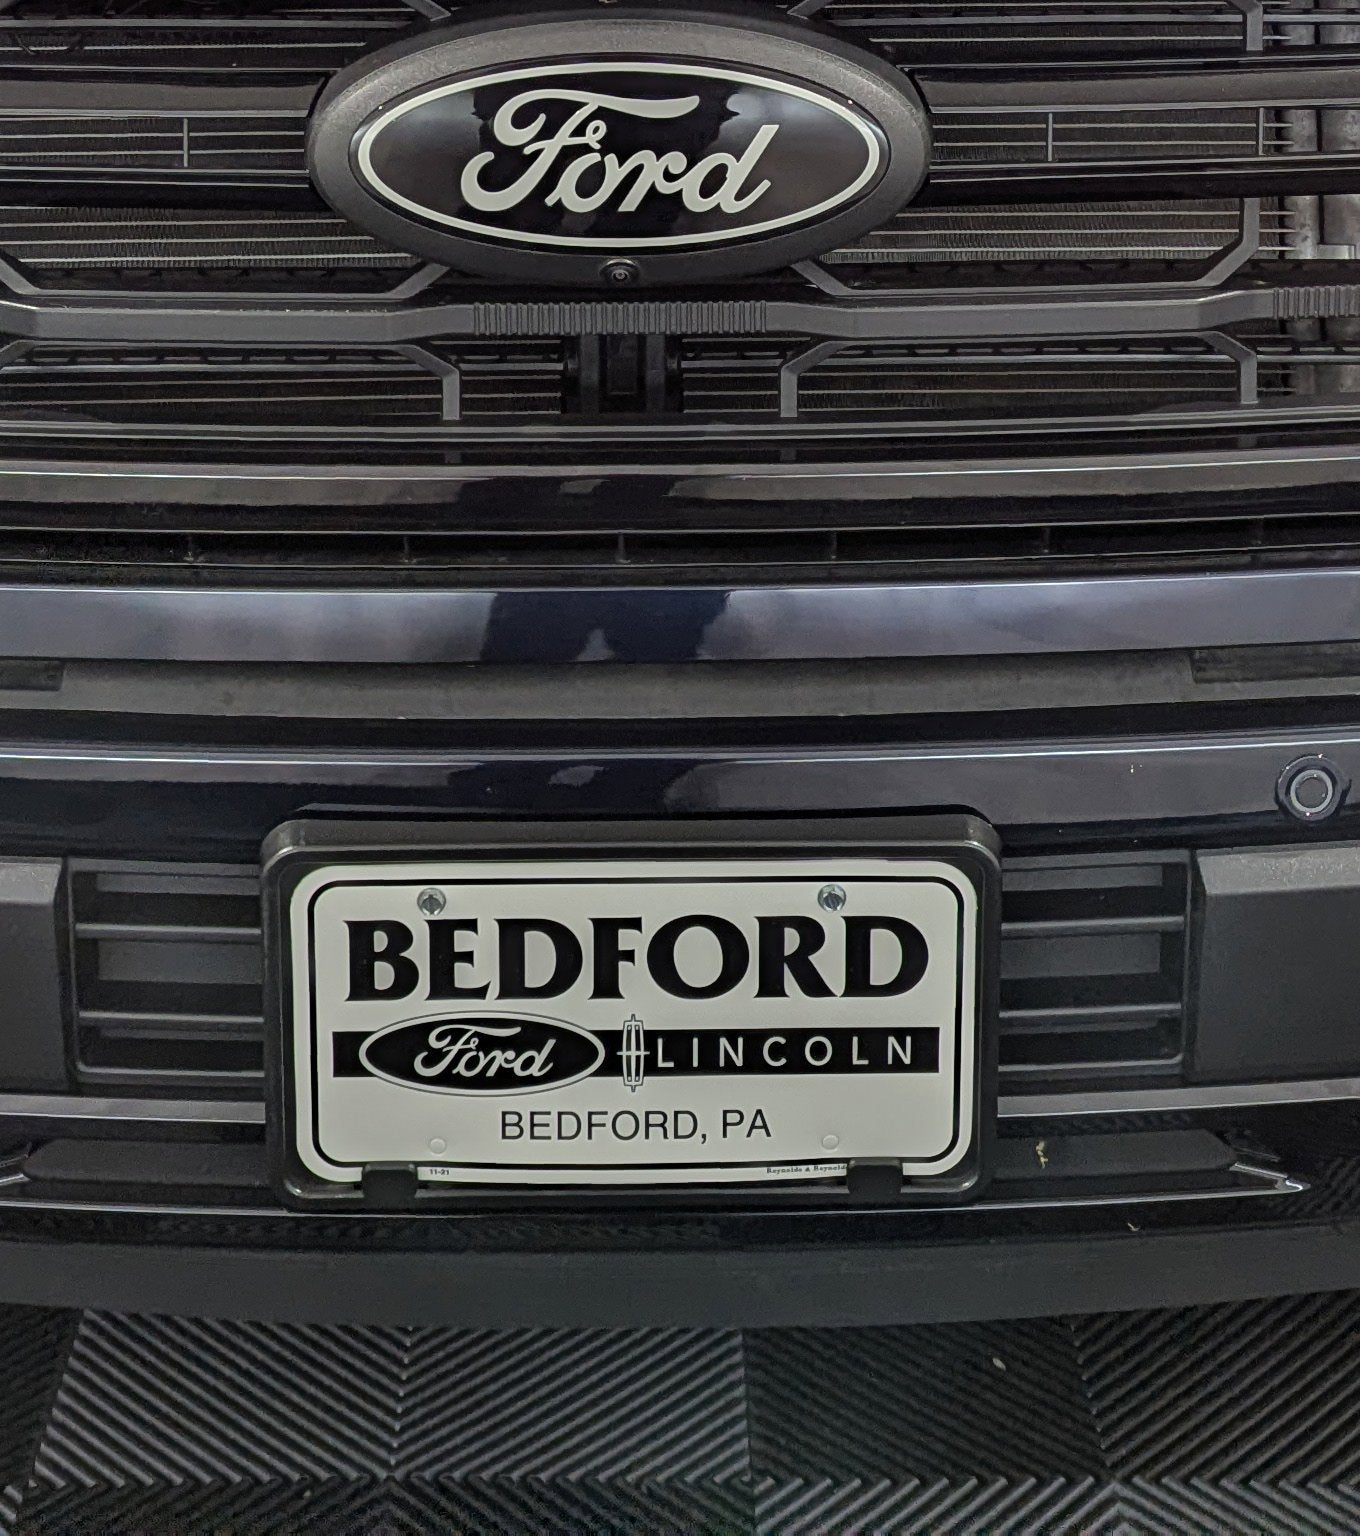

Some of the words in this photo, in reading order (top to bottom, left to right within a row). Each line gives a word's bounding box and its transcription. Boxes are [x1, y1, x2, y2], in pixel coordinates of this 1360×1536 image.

[460, 88, 780, 214] Ford
[343, 914, 929, 1000] BEDFORD
[413, 1023, 555, 1080] Ford
[656, 1035, 913, 1069] LINCOLN
[499, 1109, 709, 1145] BEDFORD,
[721, 1107, 773, 1140] PA
